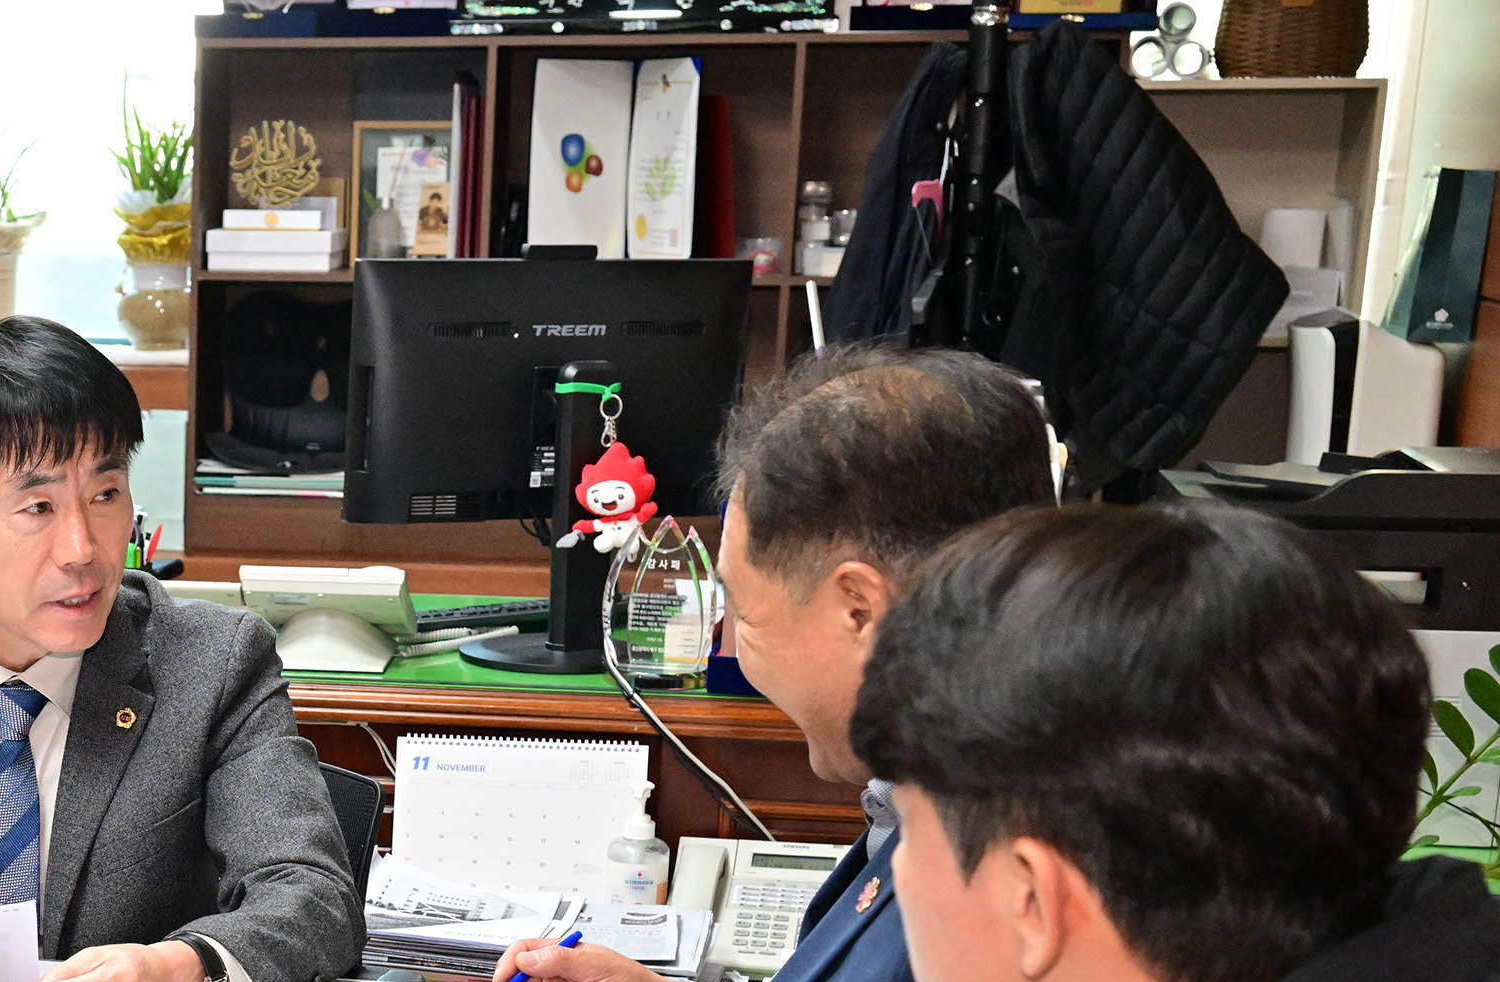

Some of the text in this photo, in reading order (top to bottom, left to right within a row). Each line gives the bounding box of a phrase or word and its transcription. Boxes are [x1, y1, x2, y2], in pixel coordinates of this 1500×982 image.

[532, 324, 607, 337] TREEM
[647, 558, 681, 571] 감사패
[412, 756, 486, 773] 11 NOVEMBER
